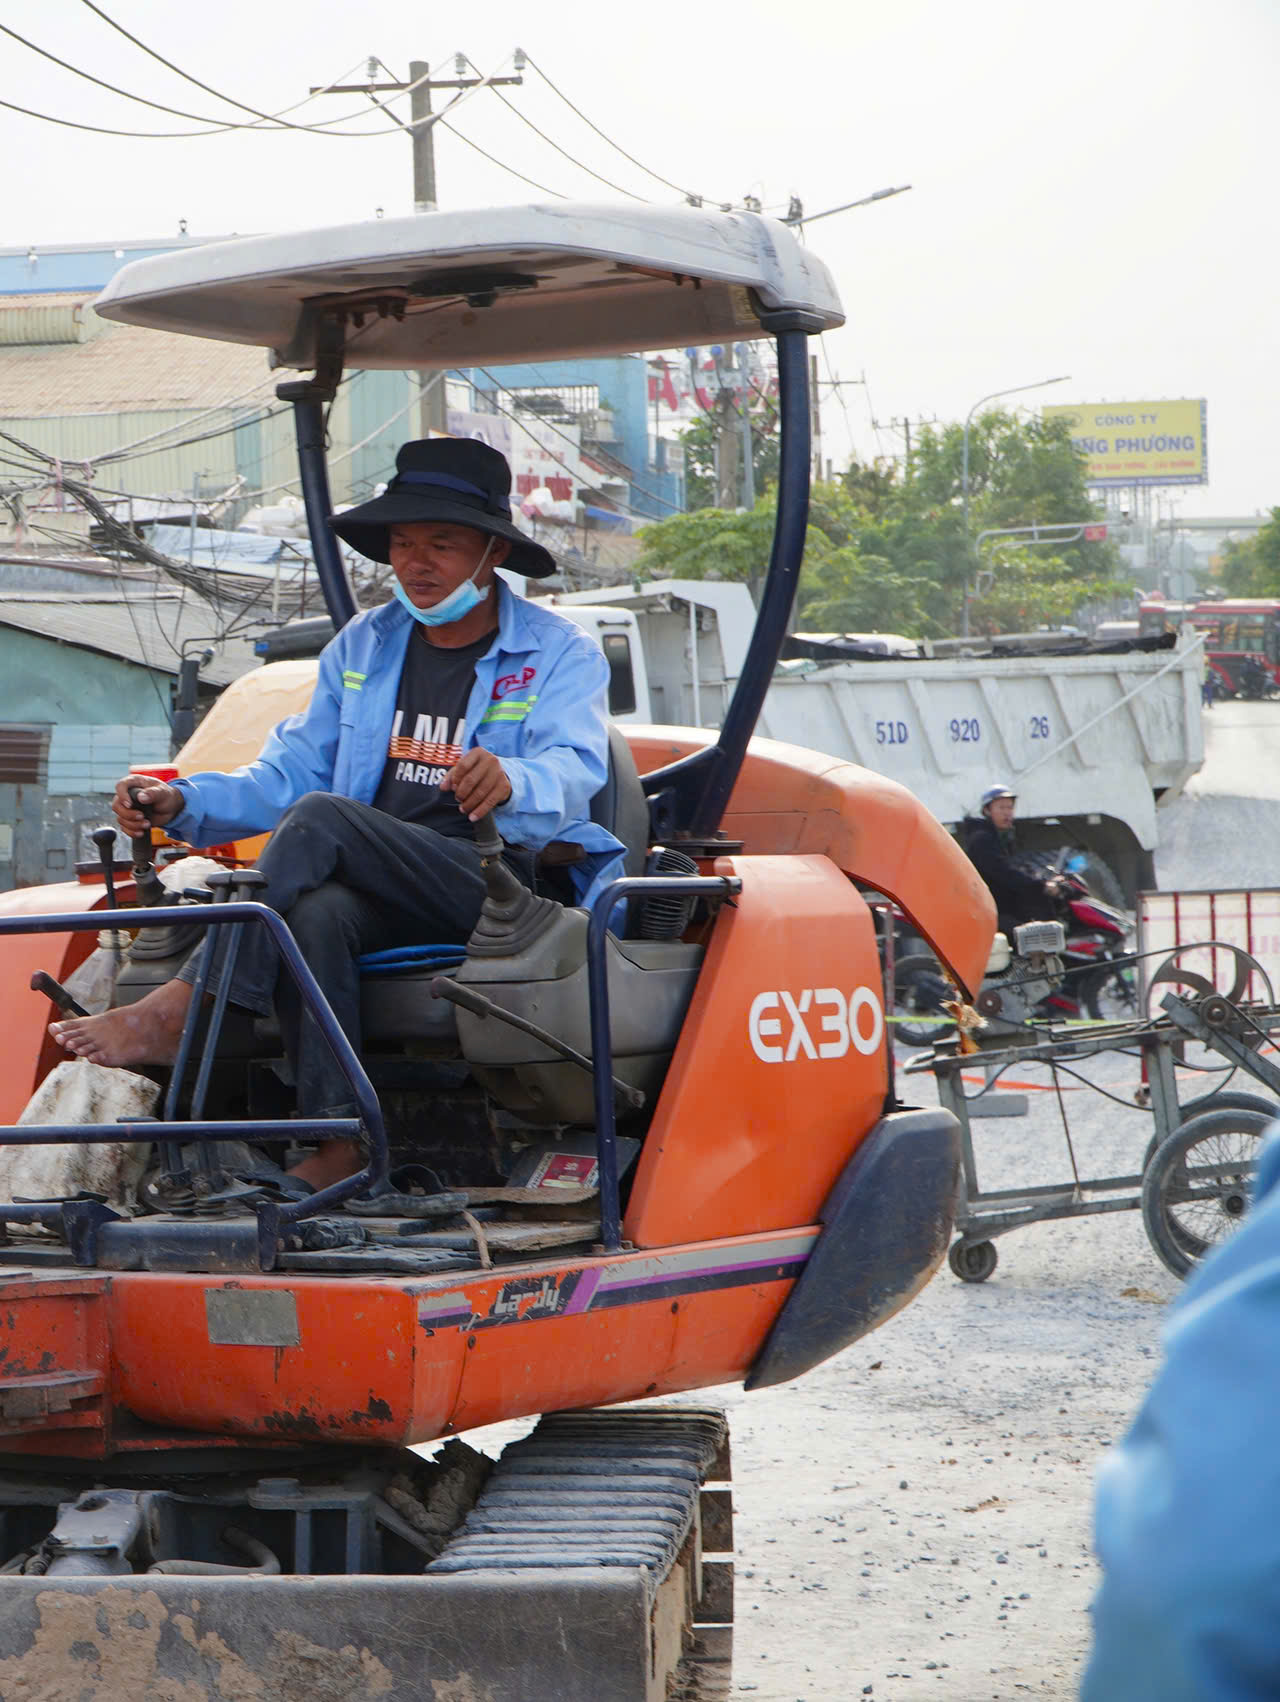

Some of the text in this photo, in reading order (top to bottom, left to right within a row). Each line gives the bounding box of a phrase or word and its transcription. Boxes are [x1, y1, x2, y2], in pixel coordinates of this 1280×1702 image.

[1140, 414, 1158, 424] TY
[876, 716, 1049, 744] 51D 920 26
[395, 761, 448, 786] PARIS
[748, 986, 883, 1063] EX30
